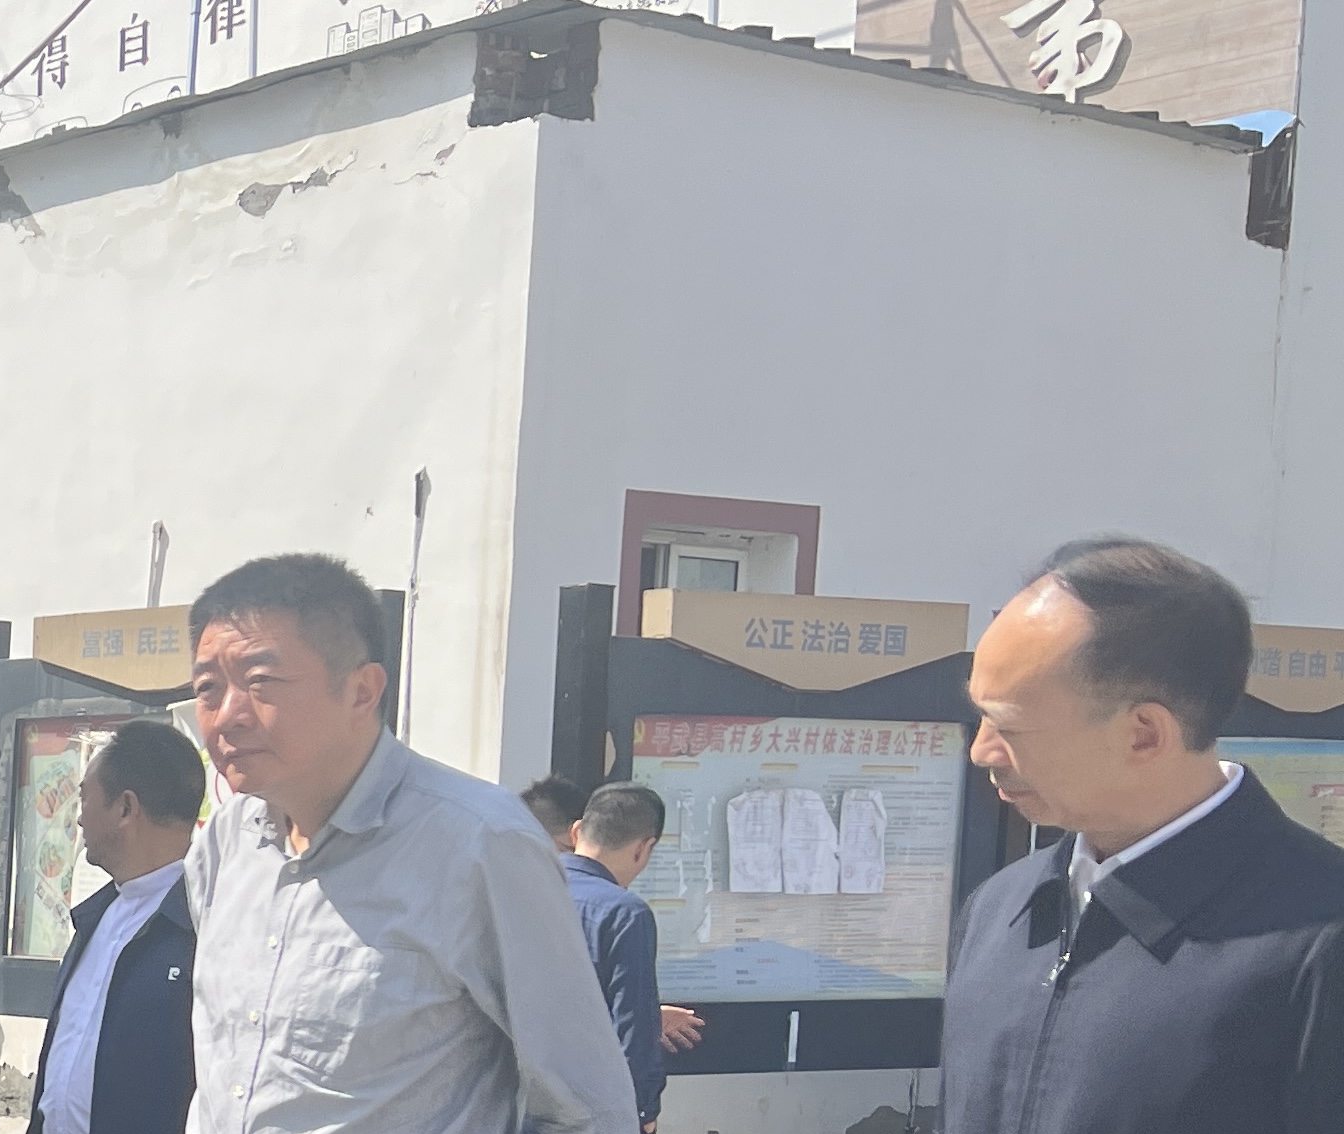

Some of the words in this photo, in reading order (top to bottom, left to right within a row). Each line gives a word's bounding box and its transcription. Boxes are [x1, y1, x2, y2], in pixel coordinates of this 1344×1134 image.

[81, 628, 124, 658] 富强
[137, 626, 180, 655] 民主
[744, 617, 795, 650] 公正
[801, 619, 851, 654] 法治
[858, 622, 908, 657] 爱国
[1288, 648, 1327, 678] 自由
